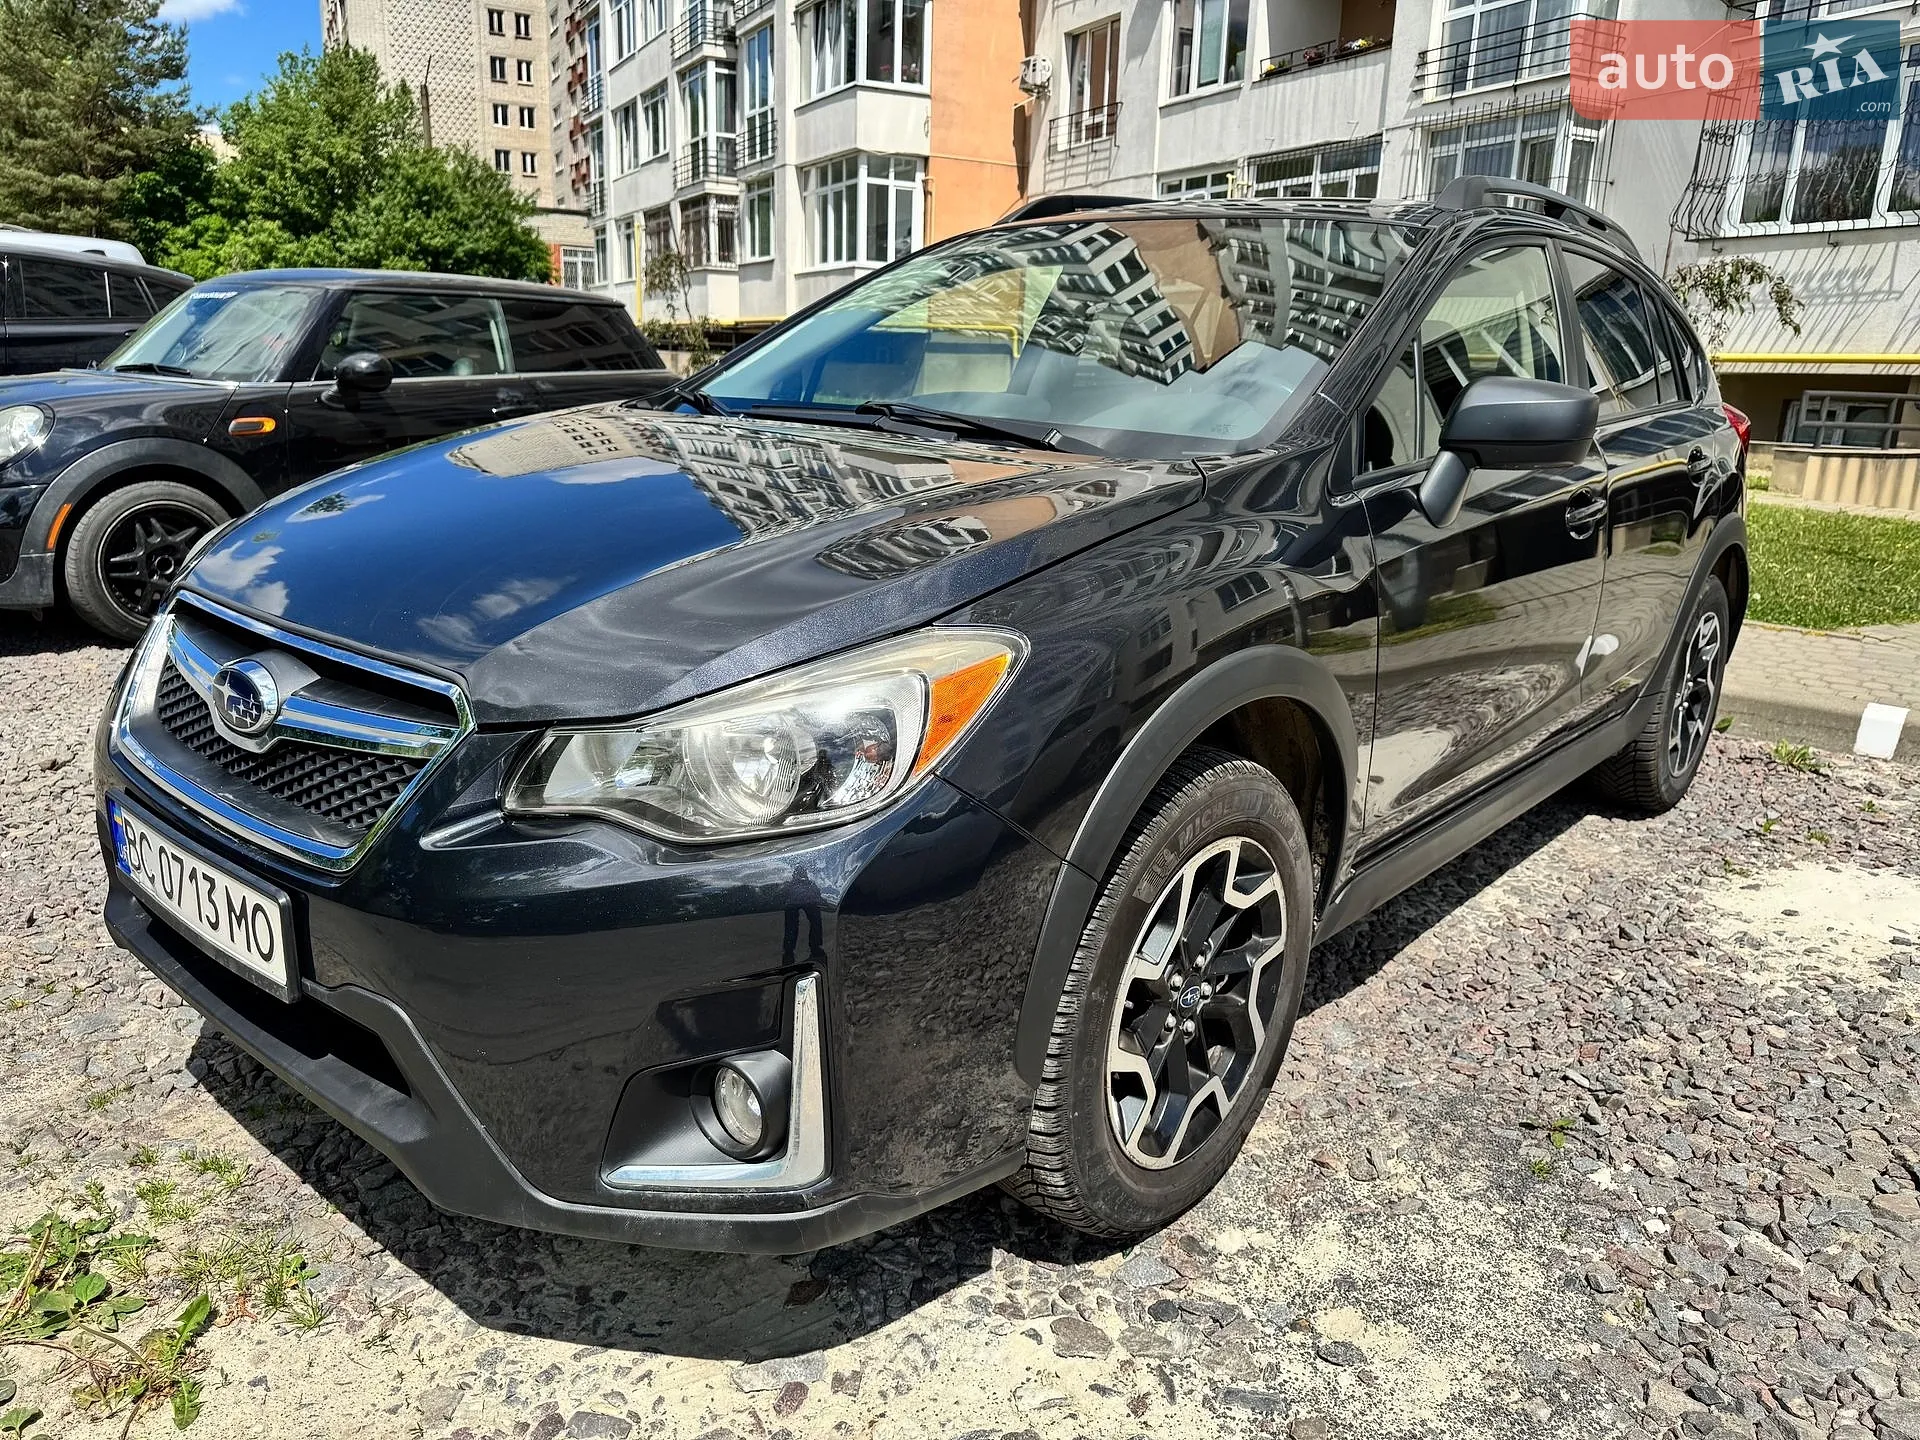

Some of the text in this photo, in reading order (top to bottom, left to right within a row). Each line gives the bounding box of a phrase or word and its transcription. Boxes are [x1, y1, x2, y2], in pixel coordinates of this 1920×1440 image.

[124, 815, 275, 962] BC 0713 MO
